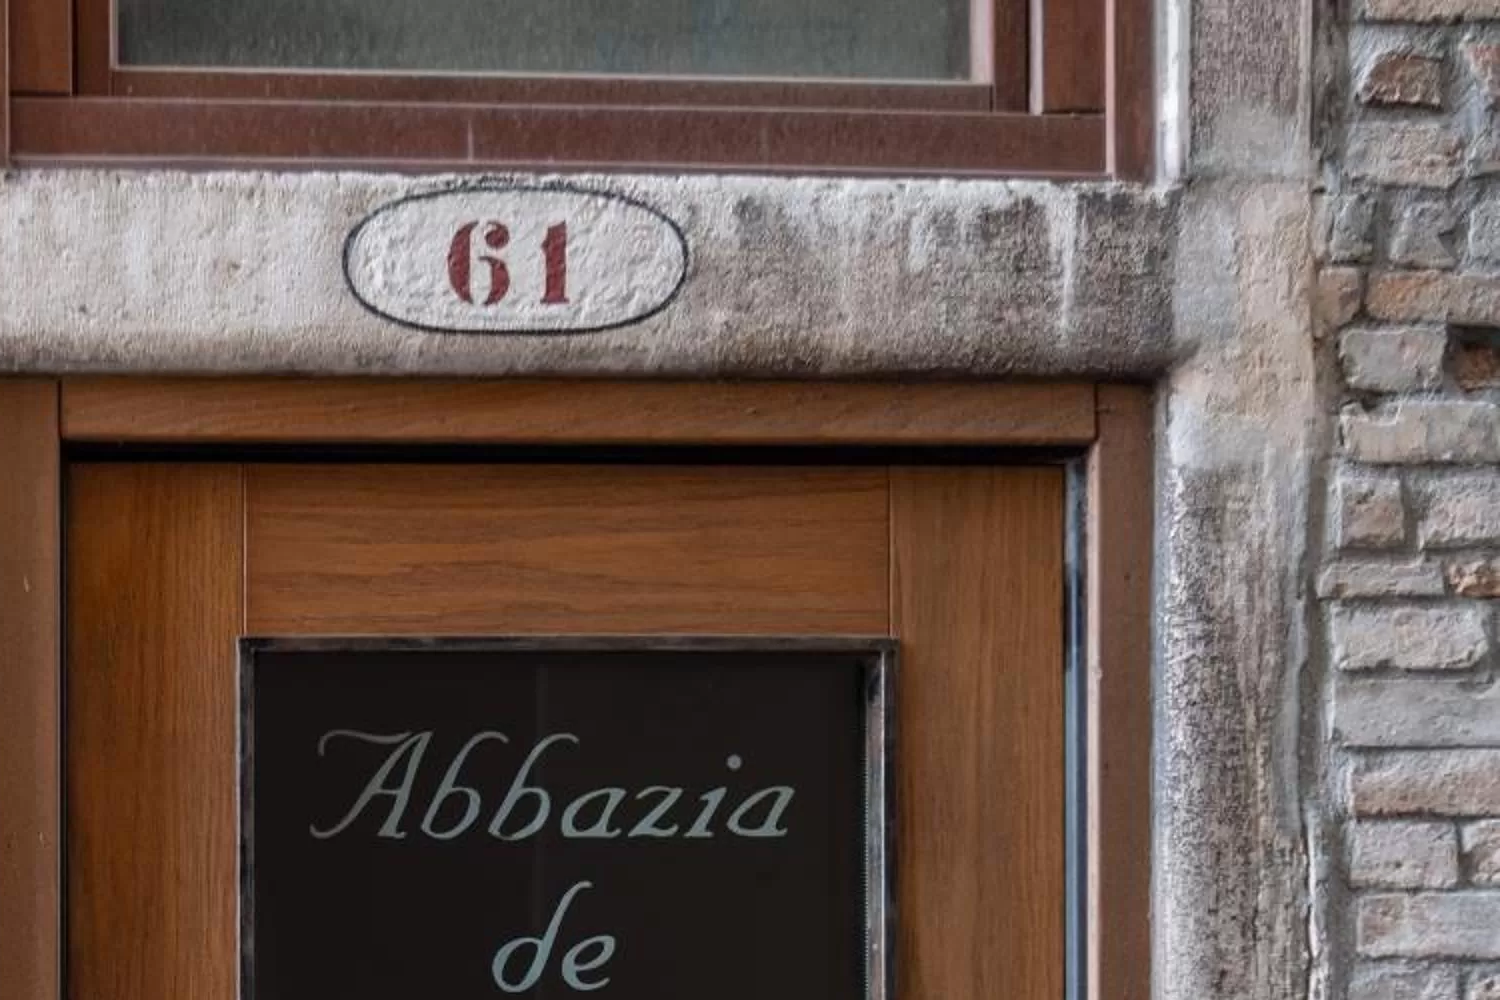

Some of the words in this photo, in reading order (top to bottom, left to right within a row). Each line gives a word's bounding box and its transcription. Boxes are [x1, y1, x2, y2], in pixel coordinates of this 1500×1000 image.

[447, 220, 570, 306] 61
[310, 730, 795, 840] Abbazia
[491, 880, 615, 992] de
